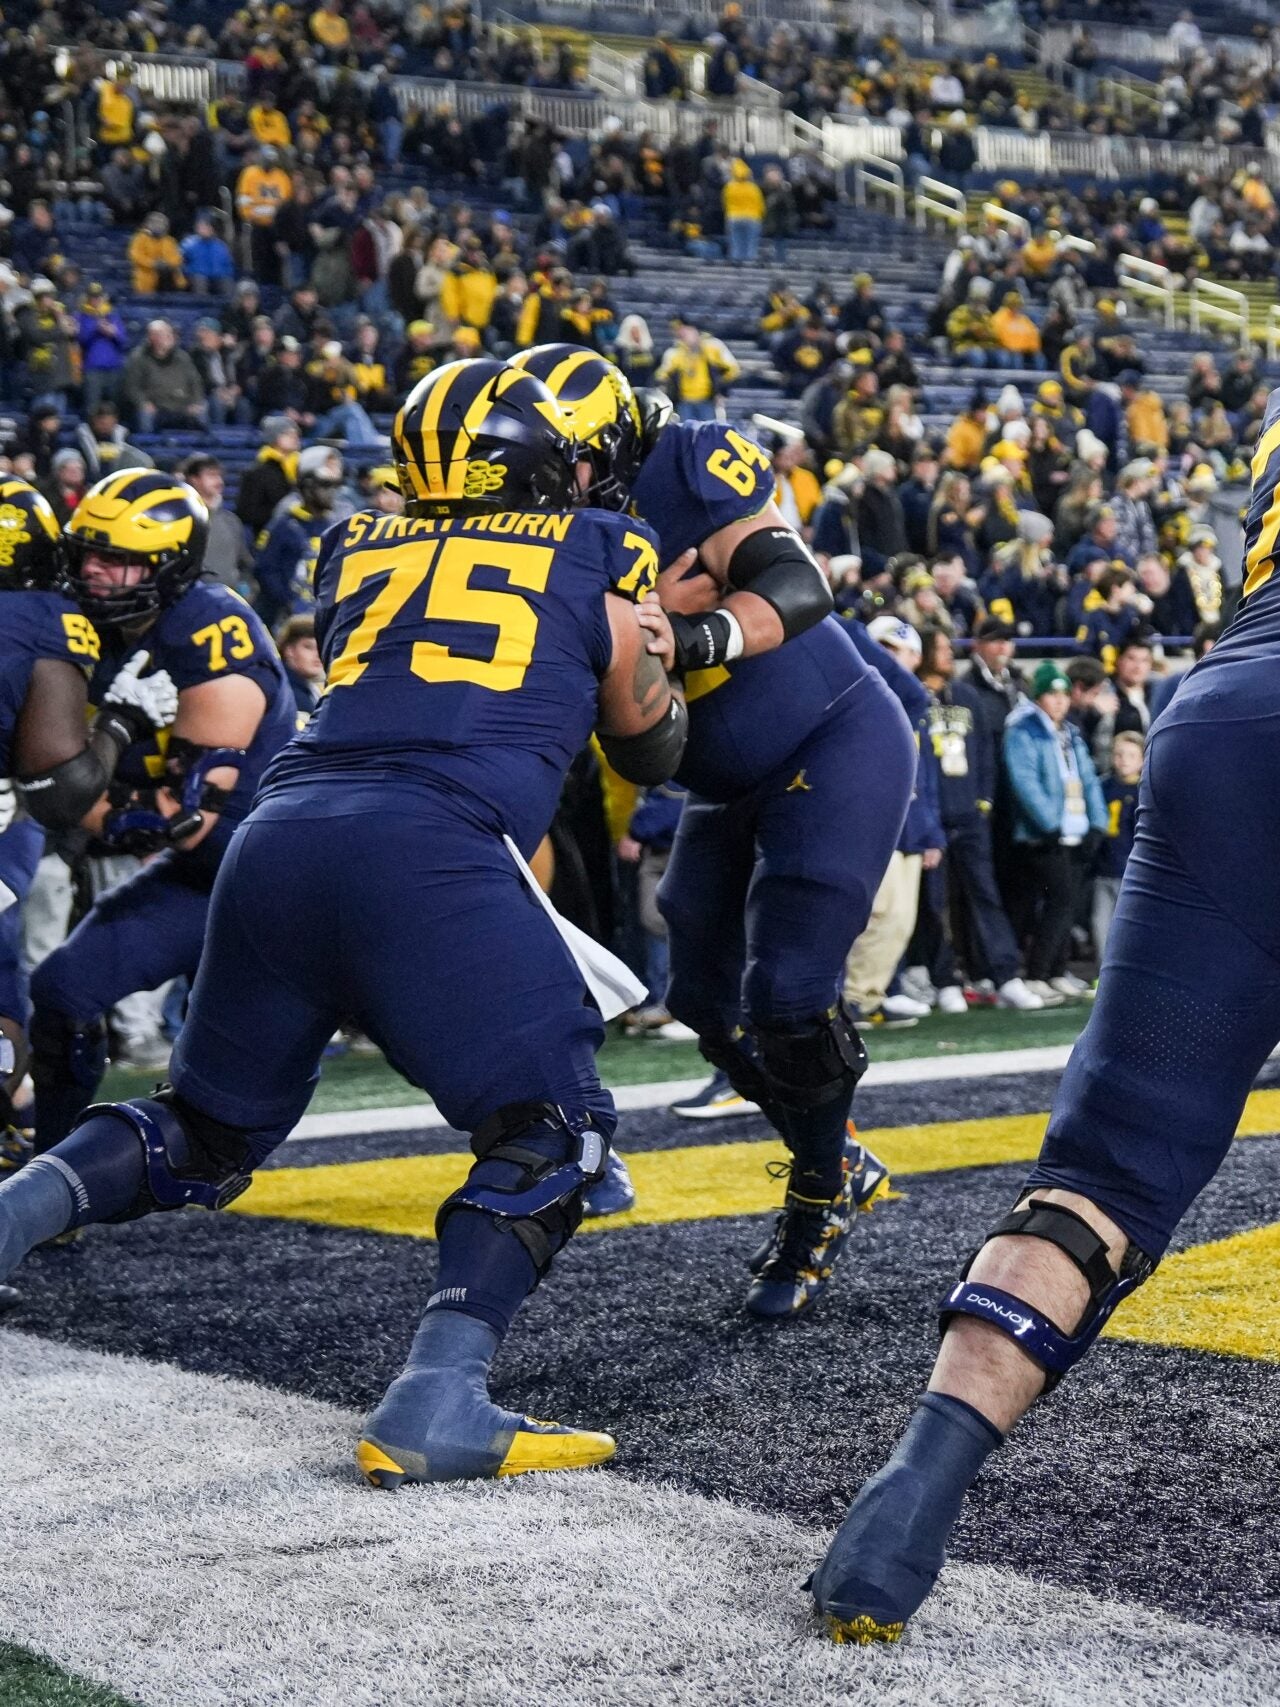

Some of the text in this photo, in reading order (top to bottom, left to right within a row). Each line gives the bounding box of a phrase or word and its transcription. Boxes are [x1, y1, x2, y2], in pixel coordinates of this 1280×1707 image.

[706, 430, 771, 496] 64
[192, 615, 255, 671] 73
[321, 536, 556, 692] 75
